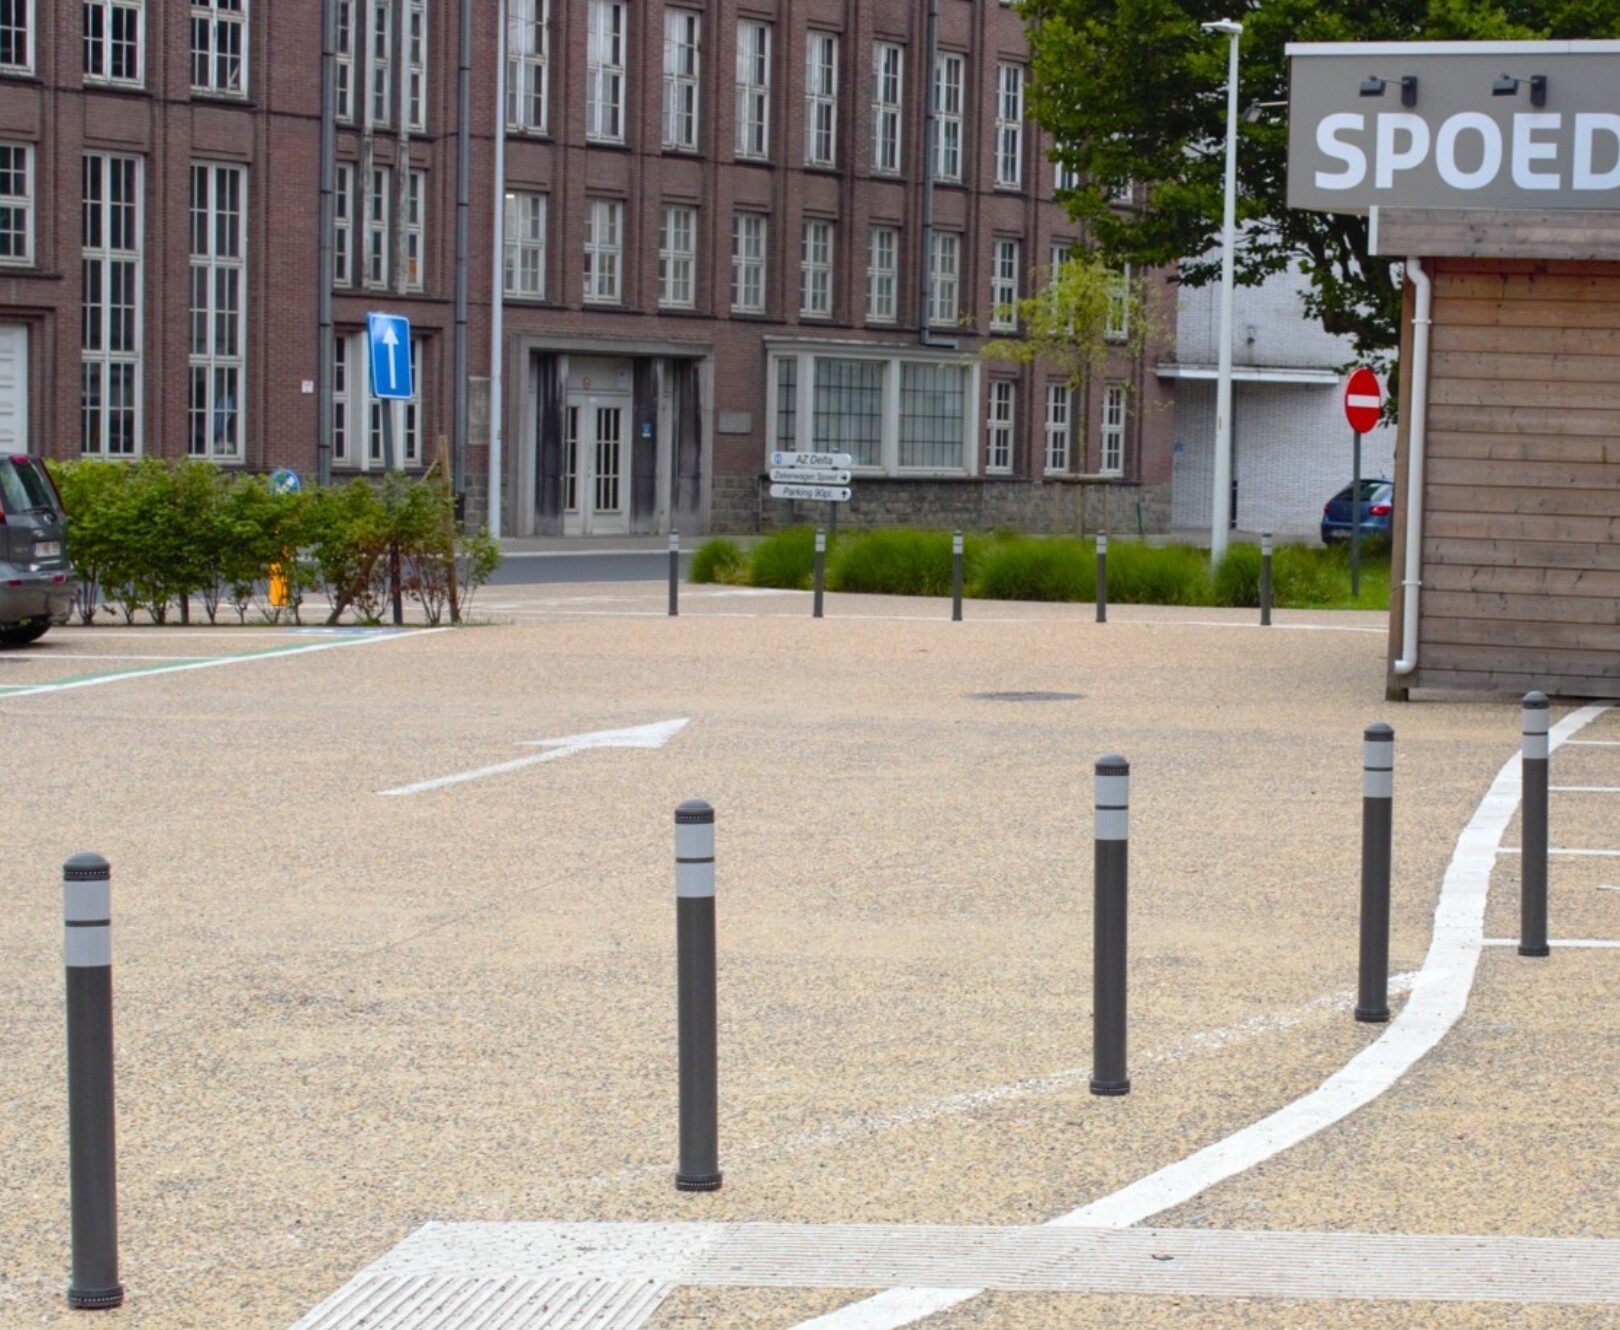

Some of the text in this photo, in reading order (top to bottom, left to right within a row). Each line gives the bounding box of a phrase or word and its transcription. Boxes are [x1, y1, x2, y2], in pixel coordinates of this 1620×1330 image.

[1315, 111, 1620, 190] SPOED
[796, 454, 808, 464] AZ
[810, 454, 833, 465] Delta
[783, 486, 812, 498] Parking
